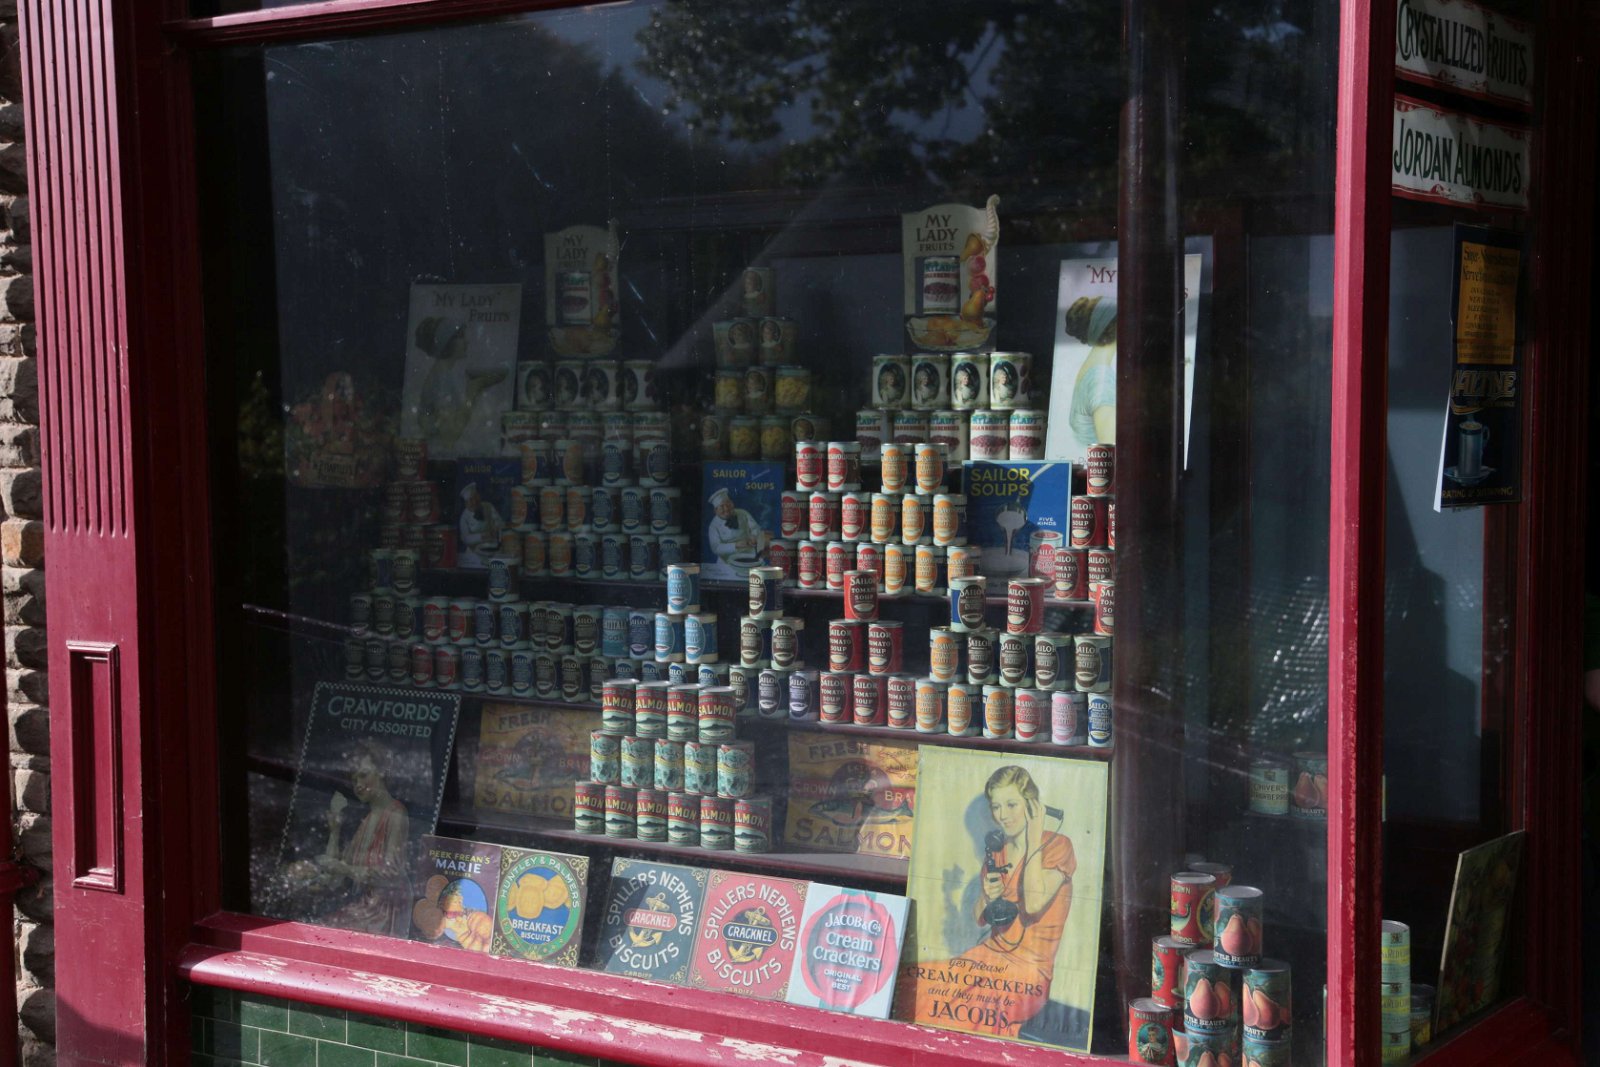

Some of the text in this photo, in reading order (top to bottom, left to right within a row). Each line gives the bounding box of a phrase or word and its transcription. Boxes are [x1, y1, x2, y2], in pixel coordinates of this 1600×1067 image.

[1398, 3, 1528, 87] CRYSTALLIZED FRUITS
[1393, 118, 1522, 194] JORDAN ALMONDS
[925, 214, 953, 228] MY
[916, 228, 959, 242] LADY
[556, 247, 589, 261] LADY
[712, 469, 747, 479] SAILOR
[970, 468, 1030, 482] SAILOR
[745, 482, 775, 491] SOUPS
[970, 483, 1030, 496] SOUPS
[328, 696, 442, 722] CRAWFORD'S
[603, 696, 633, 710] ALMON
[668, 701, 698, 714] ALMON
[340, 718, 432, 738] CITY ASSORTED
[808, 740, 871, 759] FRESH
[559, 757, 590, 773] BRAN
[575, 795, 603, 809] ALMON
[884, 790, 912, 802] BRA
[605, 798, 634, 812] ALMON
[637, 802, 668, 814] ALMON
[668, 805, 697, 820] LMON
[701, 809, 731, 823] ALMON
[735, 812, 765, 827] ALMON
[792, 817, 912, 853] SALMON
[429, 849, 491, 865] PEEK FREAN'S
[436, 858, 482, 875] MARIE
[501, 856, 538, 898] HUNTLEY
[549, 858, 580, 908] PALMERS
[607, 870, 694, 936] SPILLERS NEPHEWS
[630, 911, 671, 928] CRACKNEL
[704, 883, 796, 951] SPILLERS NEPHEWS
[512, 918, 564, 936] BREAKFAST
[728, 925, 773, 943] CRACKNEL
[521, 931, 551, 942] BISCUITS
[826, 932, 873, 953] Cream
[609, 933, 680, 970] BISCUITS
[813, 945, 881, 971] Crackers
[707, 948, 782, 986] BISCUITS
[824, 968, 862, 982] ORIGINAL
[832, 982, 851, 991] BEST
[907, 966, 1043, 997] CREAM CRACKERS
[928, 987, 1016, 1007] and they must be
